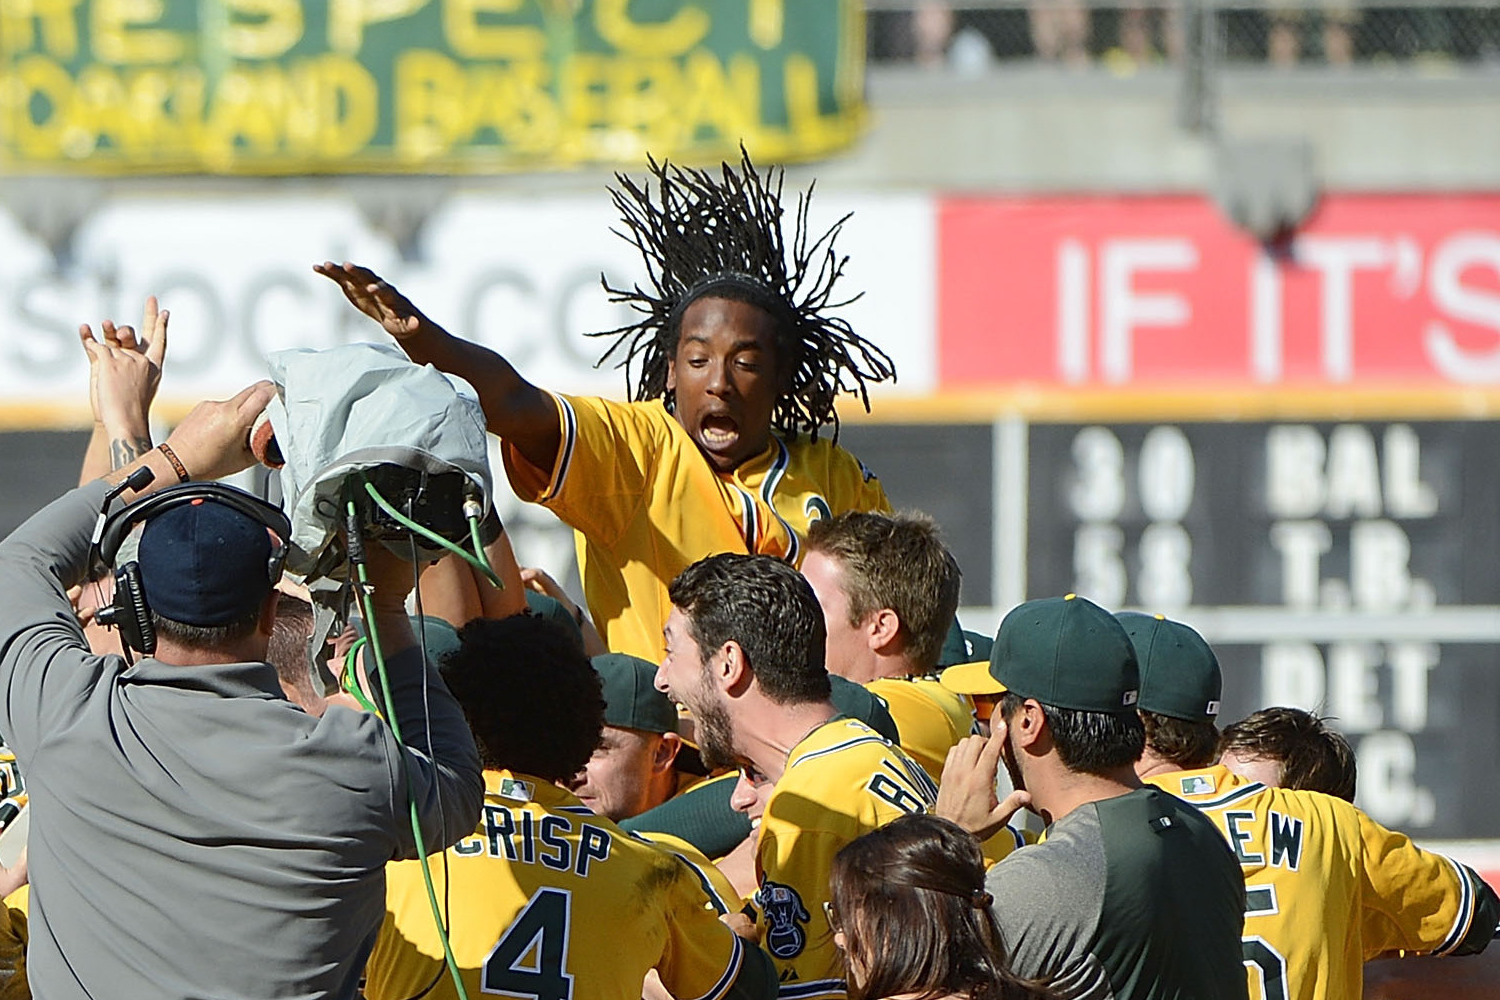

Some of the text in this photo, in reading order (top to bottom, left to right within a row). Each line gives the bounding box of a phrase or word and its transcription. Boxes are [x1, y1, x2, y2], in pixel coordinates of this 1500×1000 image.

[12, 50, 865, 162] OAKLAND BASEBALL
[1057, 230, 1500, 385] IF IT'S
[1071, 424, 1439, 522] 30 BAL
[1260, 640, 1441, 734] DET
[1225, 810, 1303, 872] EW
